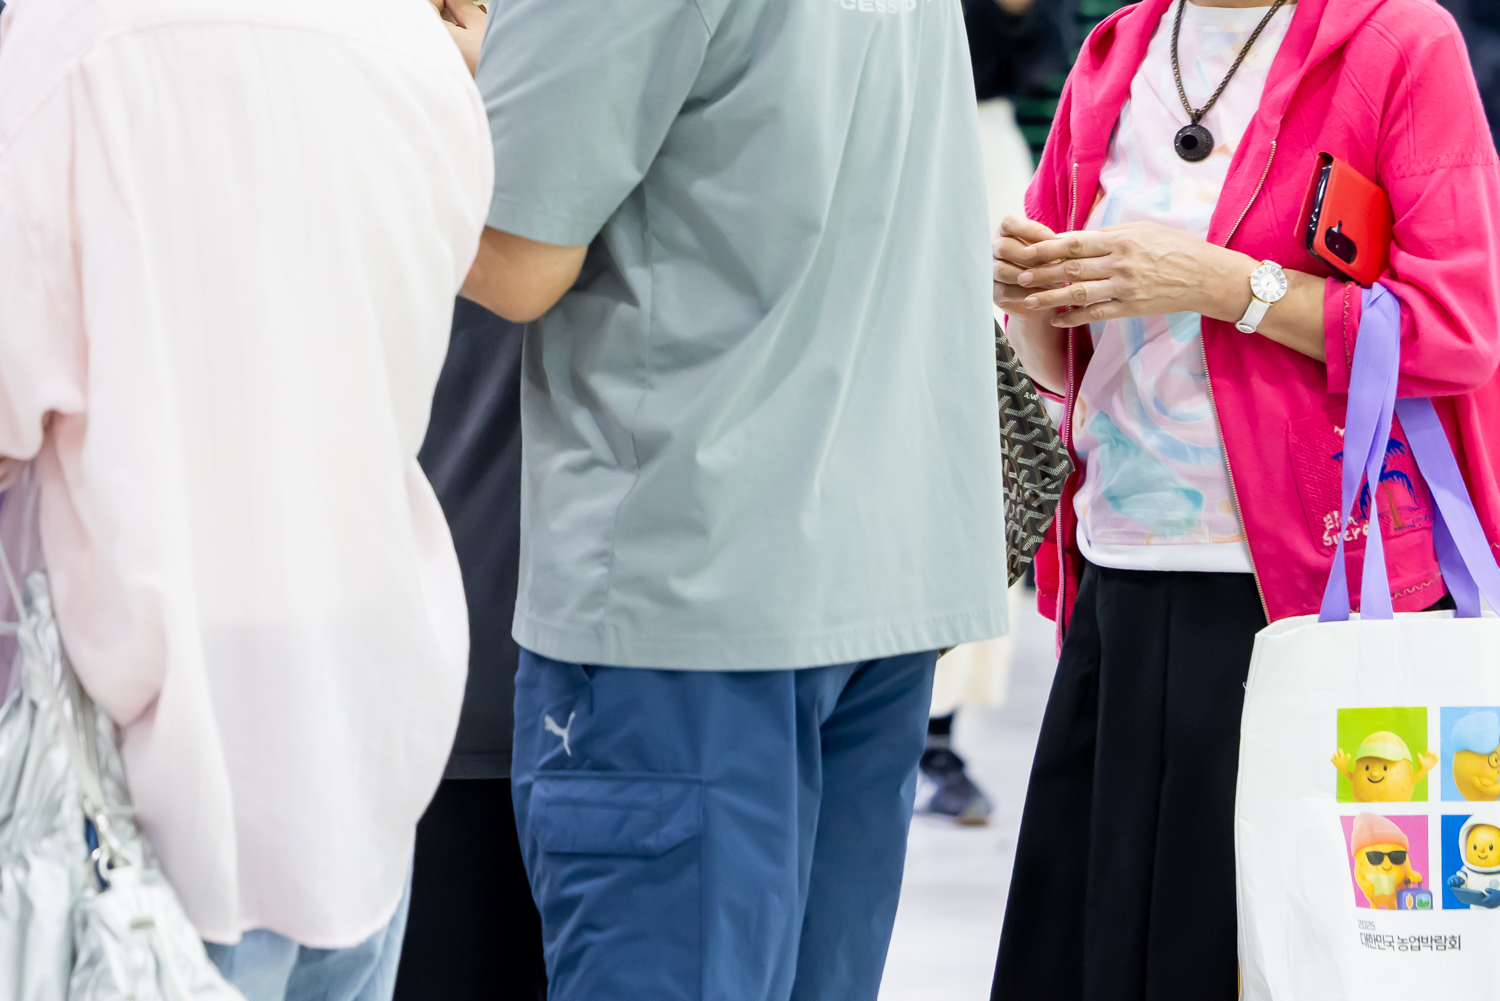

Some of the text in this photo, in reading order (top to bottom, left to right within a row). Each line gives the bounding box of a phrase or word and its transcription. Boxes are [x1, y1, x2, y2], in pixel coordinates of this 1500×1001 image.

[1358, 919, 1376, 931] 2025
[1360, 932, 1462, 951] 대한민국 농업박람회
